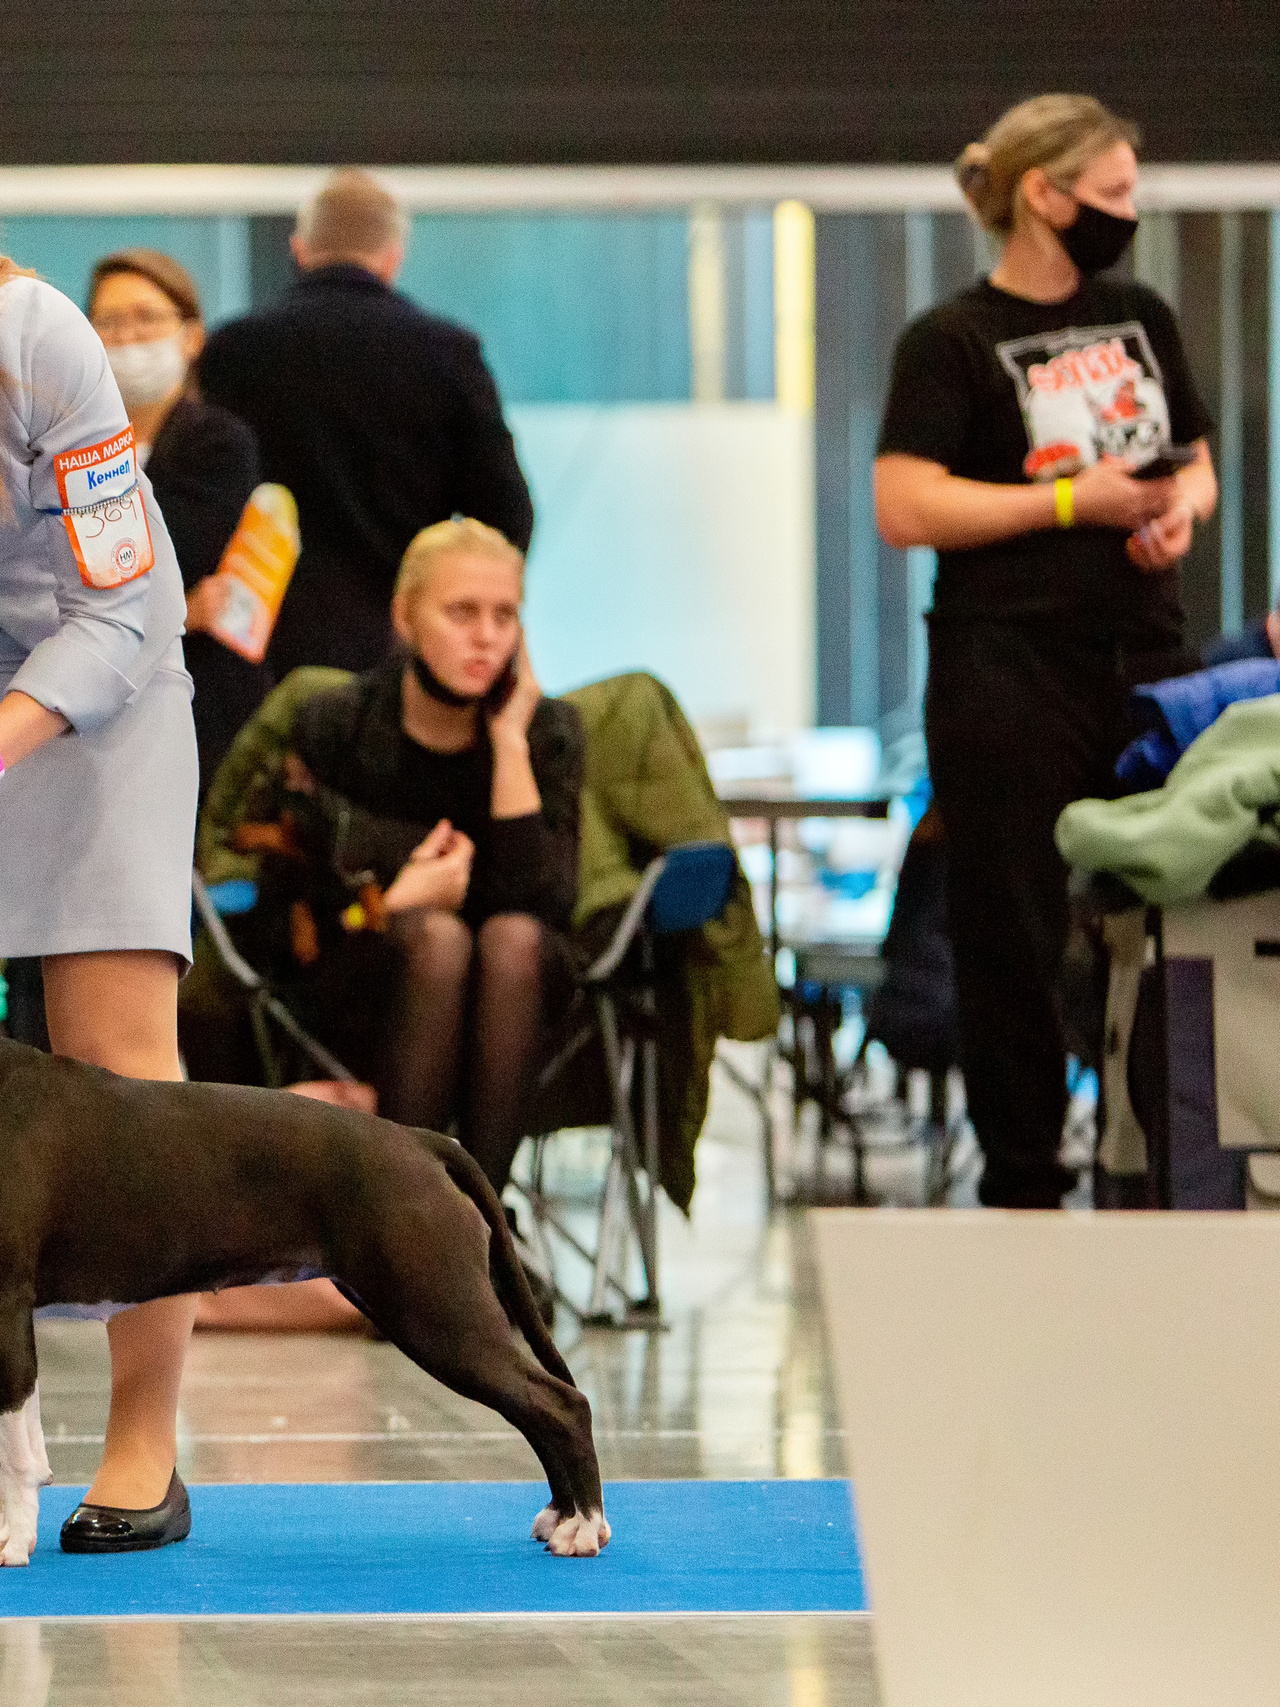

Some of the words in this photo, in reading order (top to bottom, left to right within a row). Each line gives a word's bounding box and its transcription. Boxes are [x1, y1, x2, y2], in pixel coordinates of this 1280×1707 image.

[59, 450, 101, 471] НАША
[103, 431, 133, 459] МАРКА
[86, 459, 131, 490] Кеннел
